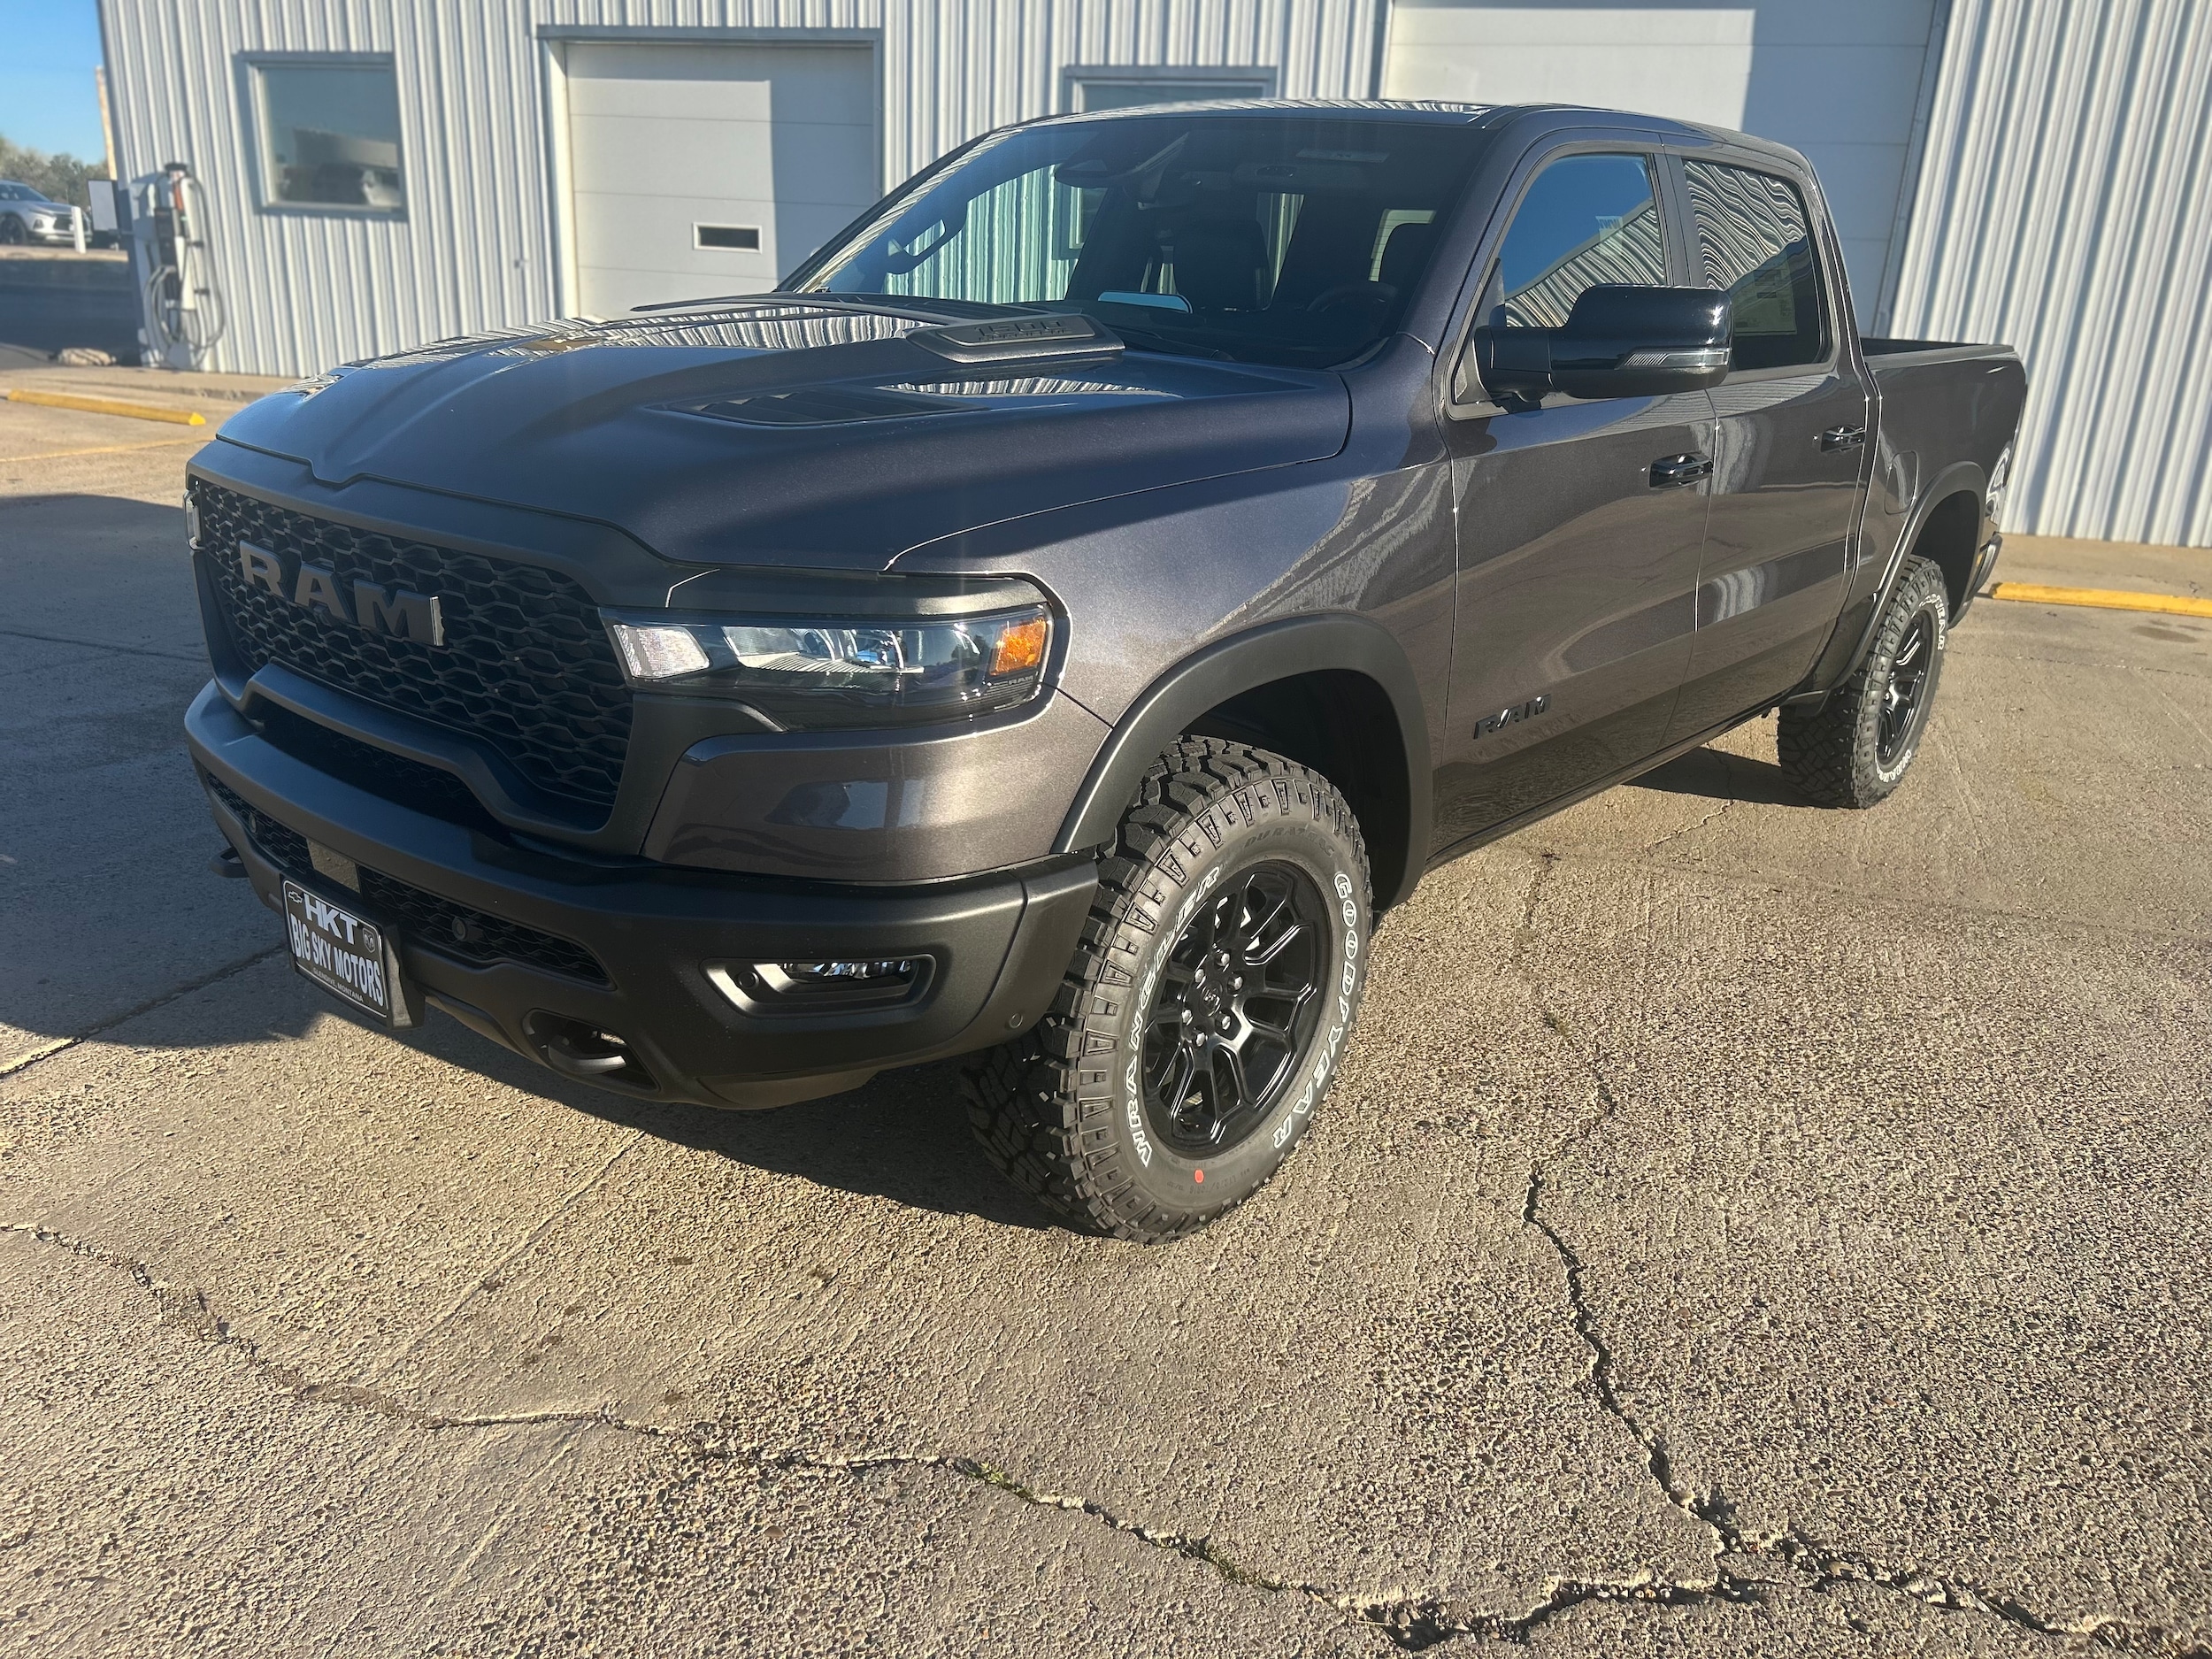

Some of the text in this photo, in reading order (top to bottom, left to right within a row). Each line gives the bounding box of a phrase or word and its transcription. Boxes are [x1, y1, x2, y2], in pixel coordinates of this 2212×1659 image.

[239, 540, 444, 647] RAM
[1472, 694, 1552, 740] RAM
[290, 913, 384, 1007] BIG SKY MOTORS
[303, 893, 358, 945] HKT
[337, 982, 364, 1003] MONTANA
[1122, 865, 1221, 1168] WRANGLER
[1271, 871, 1359, 1149] GOODYEAR
